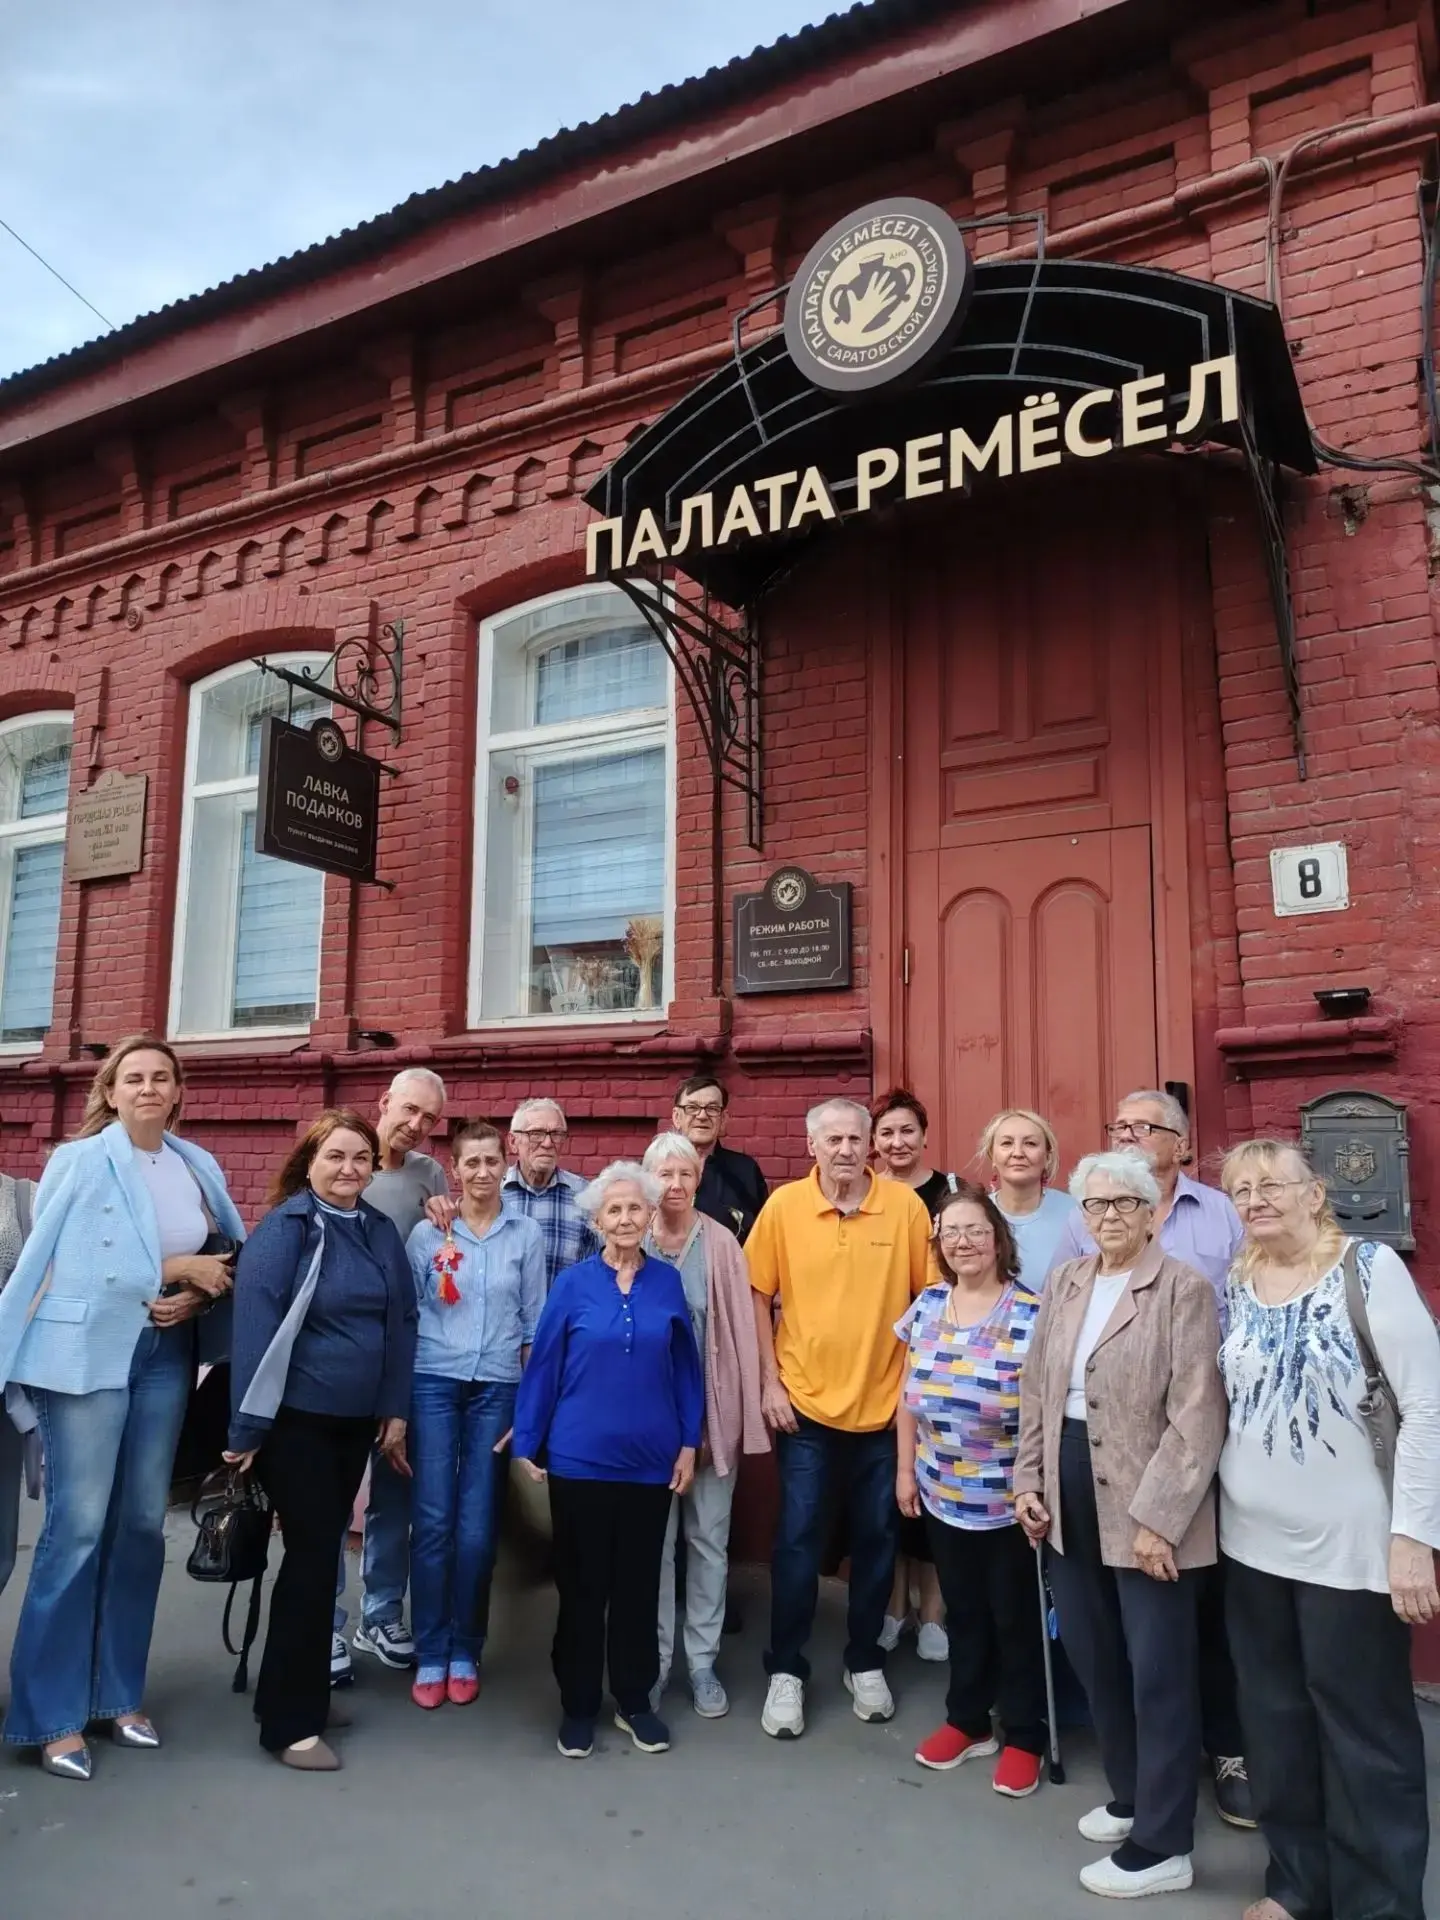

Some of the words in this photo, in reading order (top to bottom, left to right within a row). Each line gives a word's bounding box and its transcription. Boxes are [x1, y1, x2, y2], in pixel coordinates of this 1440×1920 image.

[805, 269, 831, 350] ПАЛАТА
[831, 217, 919, 263] РЕМЁСЕЛ
[827, 311, 924, 363] САРАТОВСКОЙ
[917, 238, 937, 307] ОБЛАСТИ
[586, 465, 839, 576] ПАЛАТА
[856, 354, 1240, 511] РЕМЁСЕЛ
[286, 790, 364, 829] ПОДАРКОВ
[303, 776, 350, 804] ЛАВКА
[1298, 858, 1322, 899] 8
[750, 924, 786, 936] РЕЖИМ
[788, 918, 830, 932] РАБОТЫ
